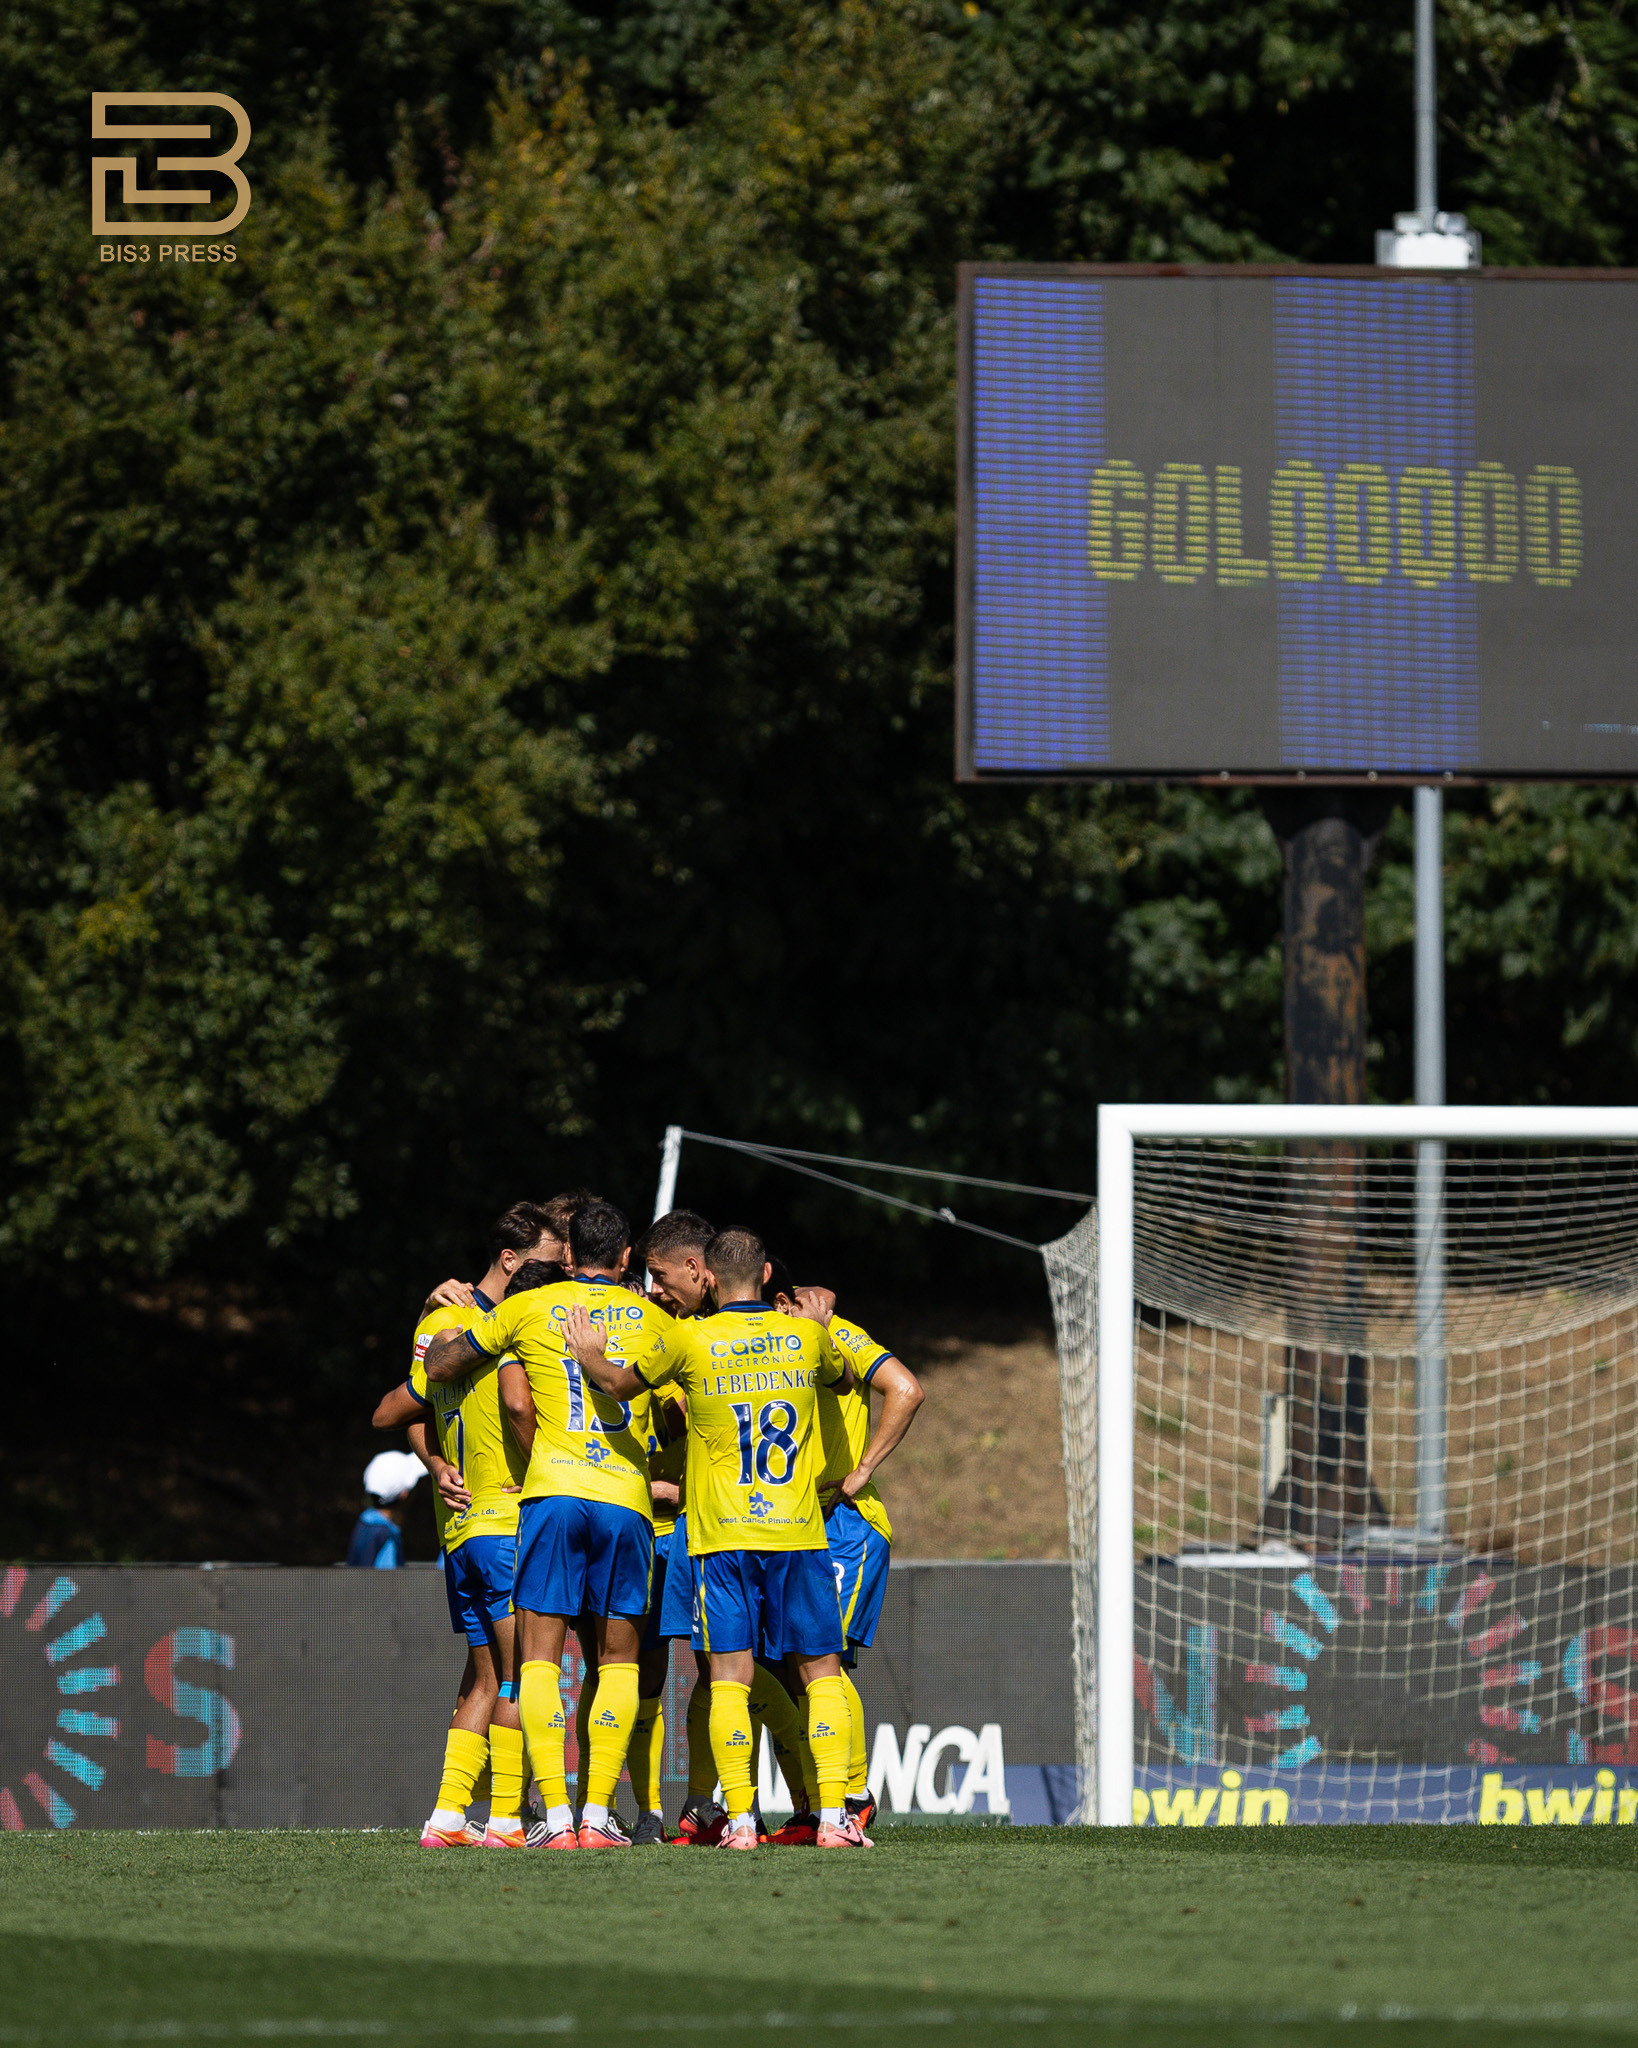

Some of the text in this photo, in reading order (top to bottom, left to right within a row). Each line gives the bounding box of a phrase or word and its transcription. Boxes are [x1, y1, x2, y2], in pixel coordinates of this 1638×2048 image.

[551, 1304, 643, 1325] cstro
[710, 1332, 802, 1358] castro
[703, 1369, 816, 1397] LEBEDENKO
[441, 1407, 465, 1488] 7
[728, 1399, 799, 1486] 18
